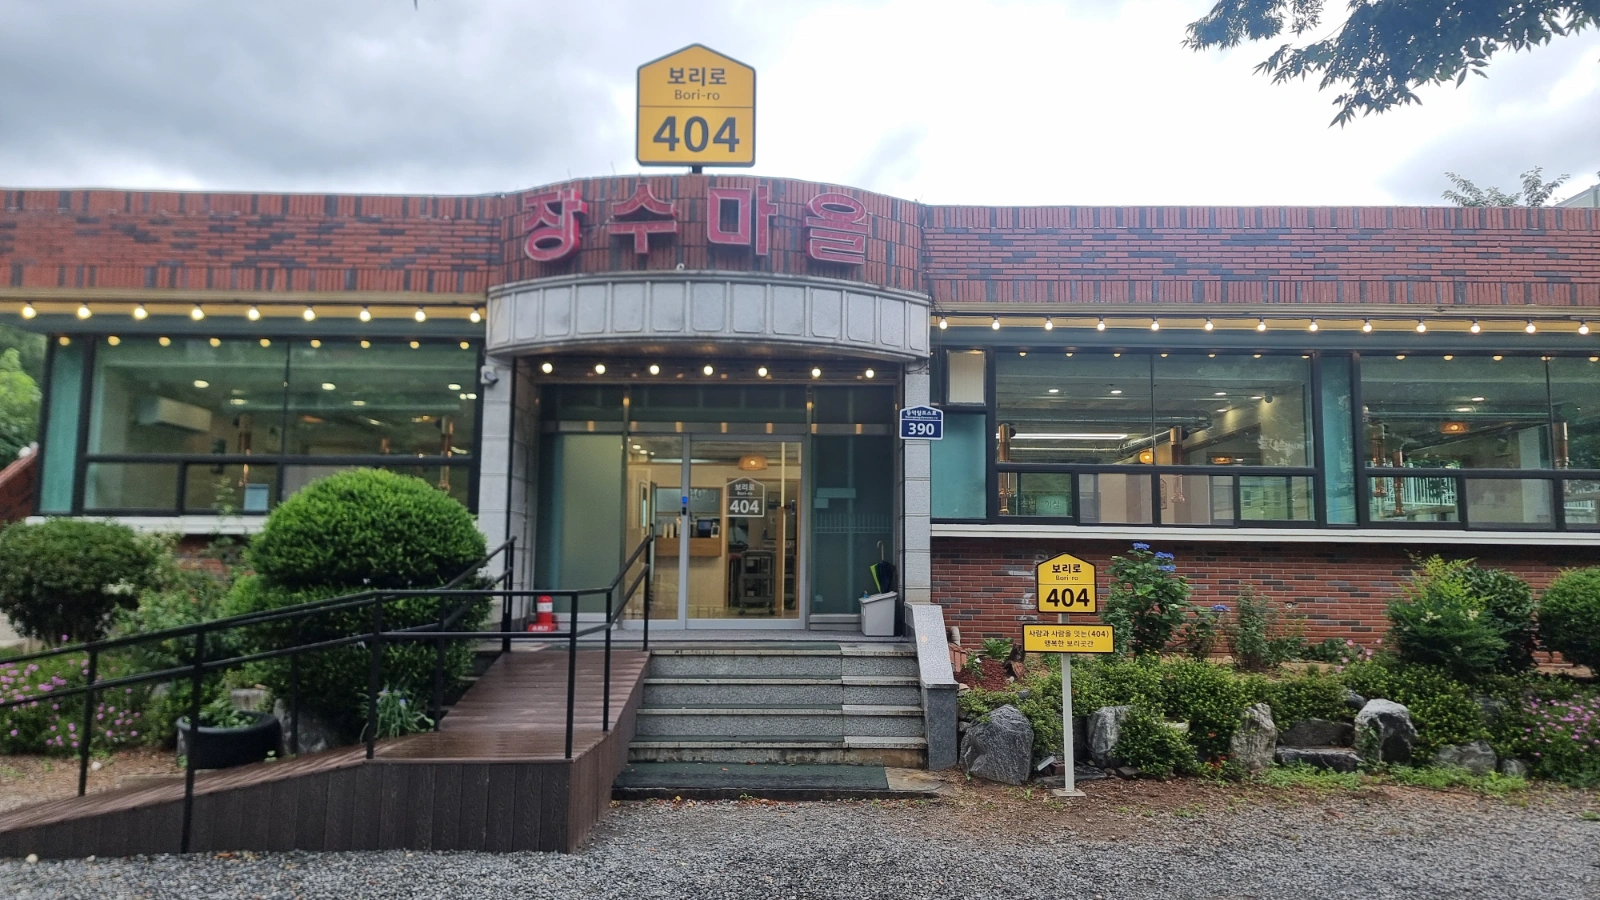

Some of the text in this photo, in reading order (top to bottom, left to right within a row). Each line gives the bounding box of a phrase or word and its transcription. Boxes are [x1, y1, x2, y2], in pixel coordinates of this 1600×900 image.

[667, 66, 727, 87] 보리로
[675, 89, 720, 101] Bori-ro
[653, 115, 740, 153] 404
[523, 183, 870, 266] 장수마을
[908, 423, 934, 435] 390
[730, 500, 759, 513] 404
[1052, 564, 1082, 574] 보리로
[1046, 588, 1090, 607] 404
[1051, 630, 1071, 638] 사람을
[1067, 640, 1094, 648] 보리곳간
